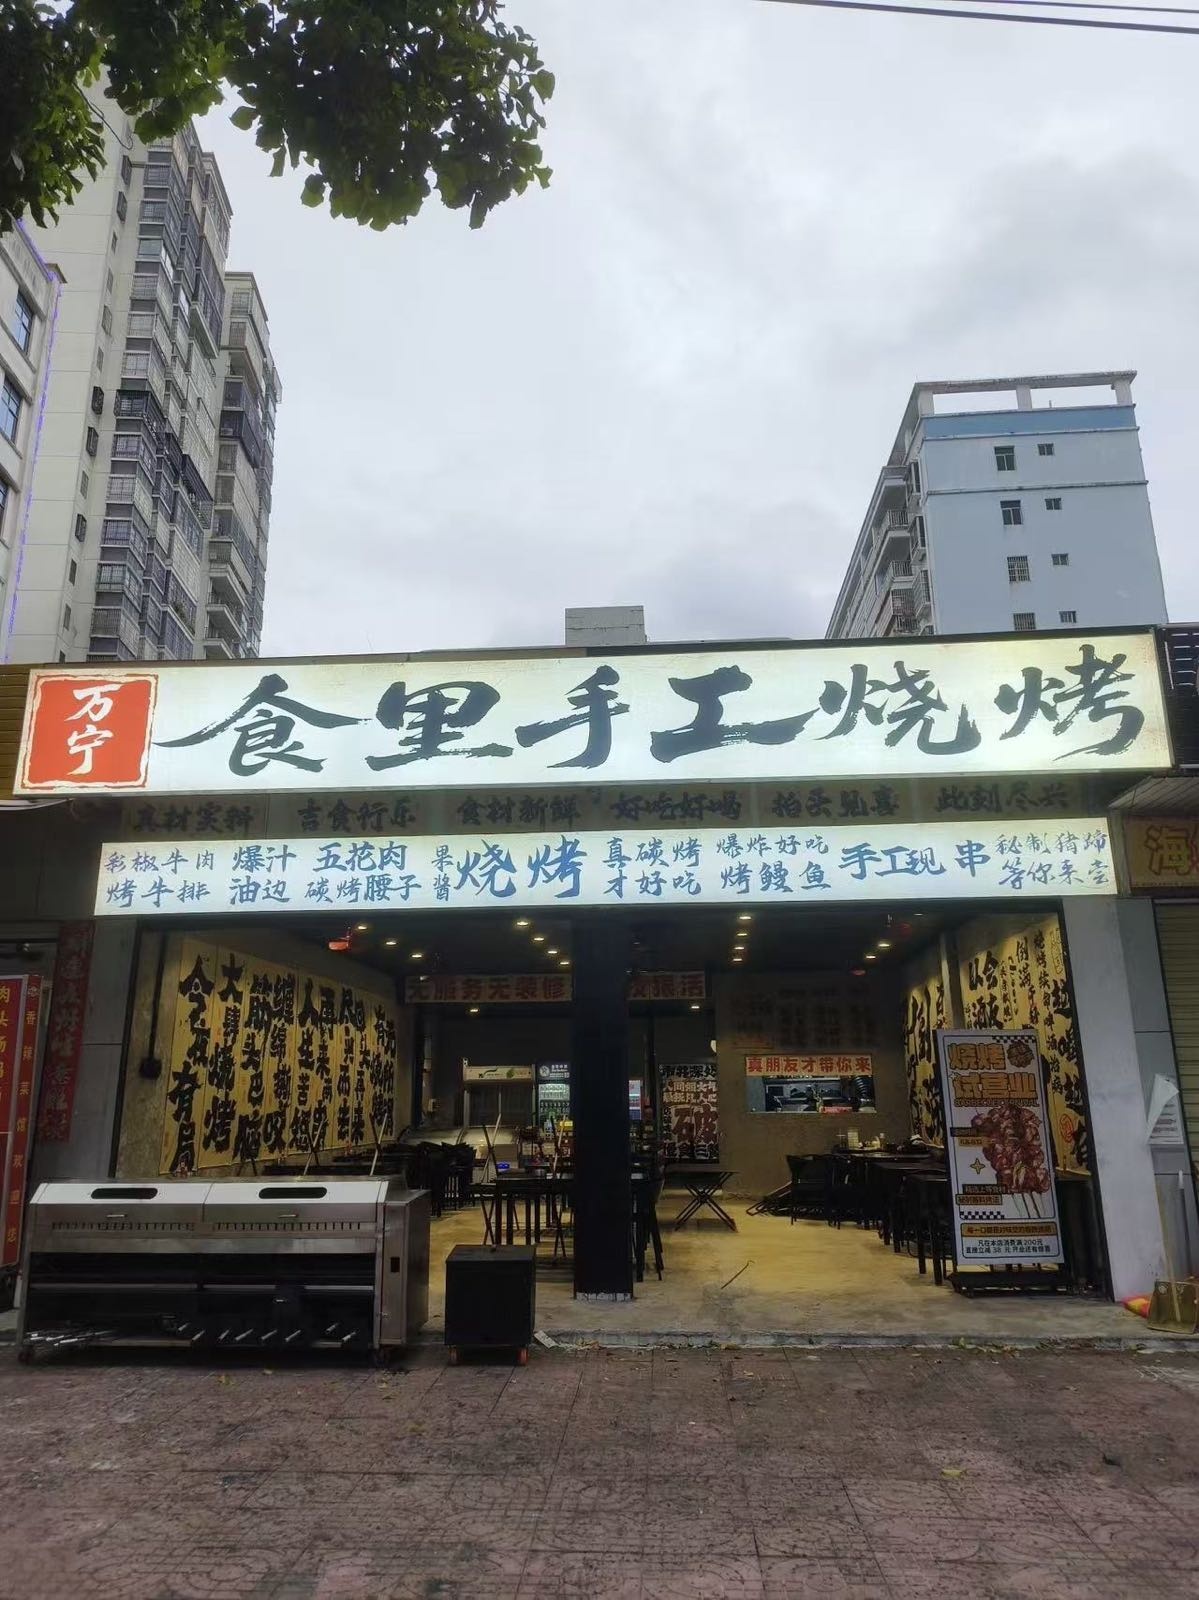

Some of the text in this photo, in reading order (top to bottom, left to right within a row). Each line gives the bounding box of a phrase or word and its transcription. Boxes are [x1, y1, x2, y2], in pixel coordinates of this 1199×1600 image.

[153, 644, 1145, 776] 食里手工烧烤
[65, 683, 115, 776] 万宁
[232, 844, 296, 873] 爆汁
[312, 841, 407, 872] 五花肉
[602, 836, 702, 868] 真碳烤
[716, 833, 829, 858] 爆炸好吃
[838, 837, 991, 880] 手工现串
[995, 830, 1107, 856] 秘制猪蹄
[1144, 824, 1199, 877] 海
[104, 848, 214, 874] 彩椒牛肉
[454, 834, 587, 898] 烧烤
[999, 854, 1110, 890] 等你来尝
[106, 876, 211, 908] 烤牛排
[229, 875, 292, 905] 油边
[304, 875, 421, 905] 碳烤腰子
[603, 867, 703, 899] 才好吃
[720, 860, 831, 895] 烤鳗鱼
[747, 1056, 872, 1074] 真朋友才带你来
[947, 1042, 1006, 1071] 烧烤
[953, 1072, 1039, 1099] 试营业
